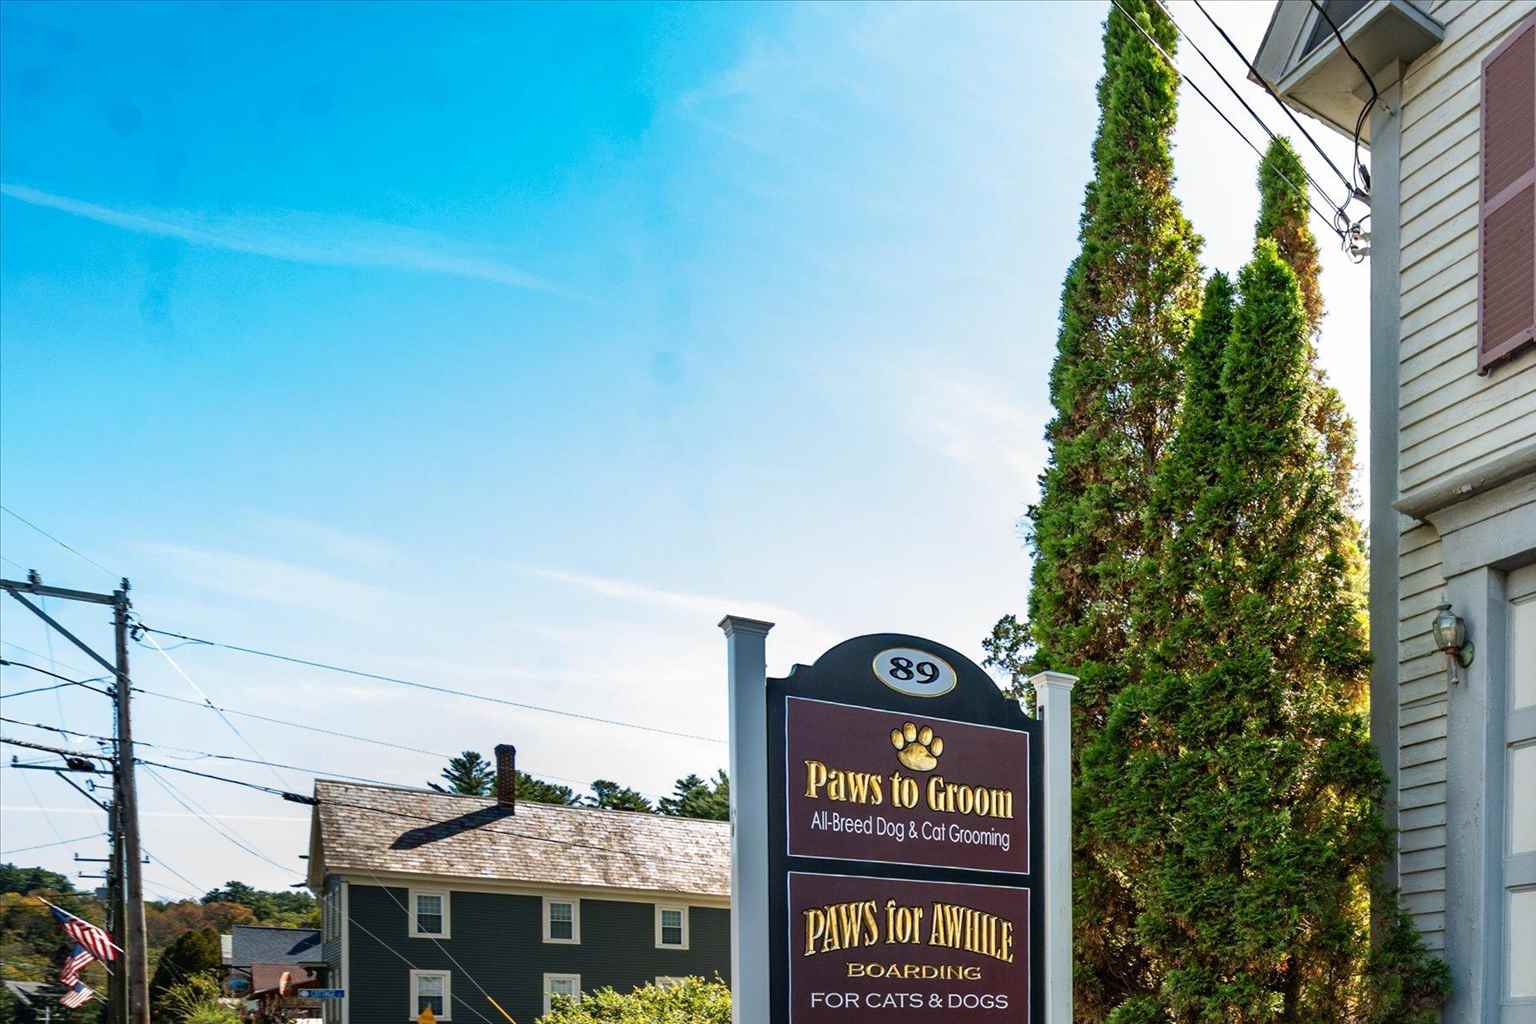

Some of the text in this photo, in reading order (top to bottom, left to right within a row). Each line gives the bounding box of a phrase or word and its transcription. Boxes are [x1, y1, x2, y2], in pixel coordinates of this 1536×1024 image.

[889, 656, 940, 684] 89
[804, 760, 1014, 819] Paws to Groom
[811, 811, 1010, 851] All-Breed Dog & Cat Grooming
[803, 899, 1014, 964] PAWS for AWHILE
[846, 962, 982, 980] BOARDING
[811, 993, 1008, 1009] FOR CATS & DOGS
